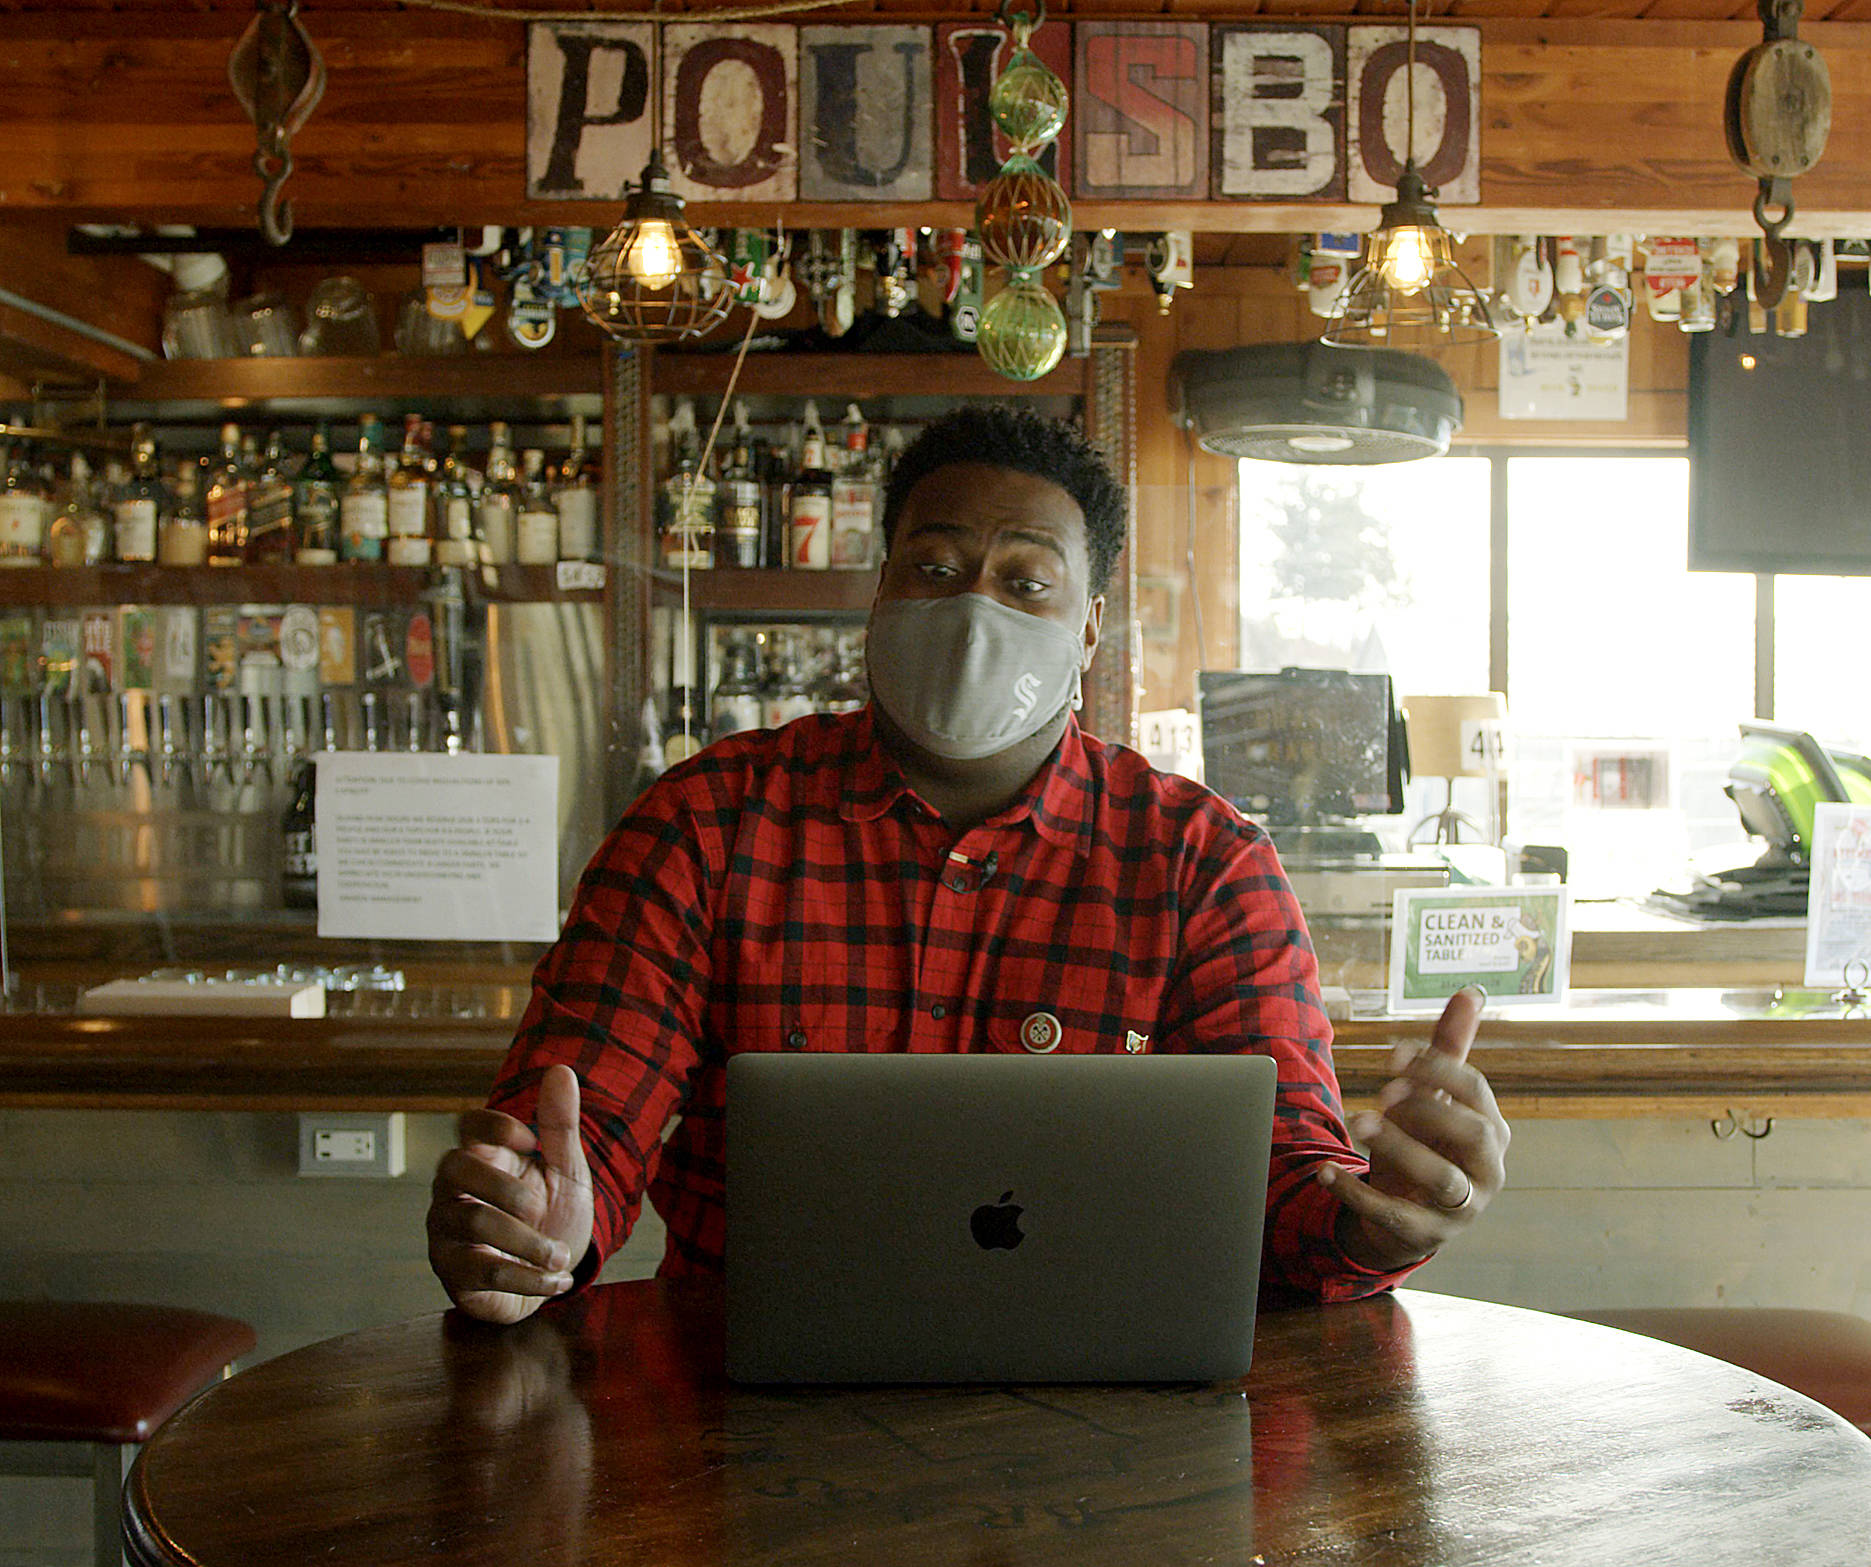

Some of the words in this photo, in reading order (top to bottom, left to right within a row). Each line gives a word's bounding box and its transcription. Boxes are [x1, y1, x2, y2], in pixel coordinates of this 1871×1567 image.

[537, 30, 1471, 195] POULSBO
[793, 516, 820, 564] 7
[1425, 913, 1485, 930] CLEAN
[1491, 915, 1505, 929] &
[1425, 932, 1500, 947] SANITIZED
[1425, 948, 1465, 961] TABLE
